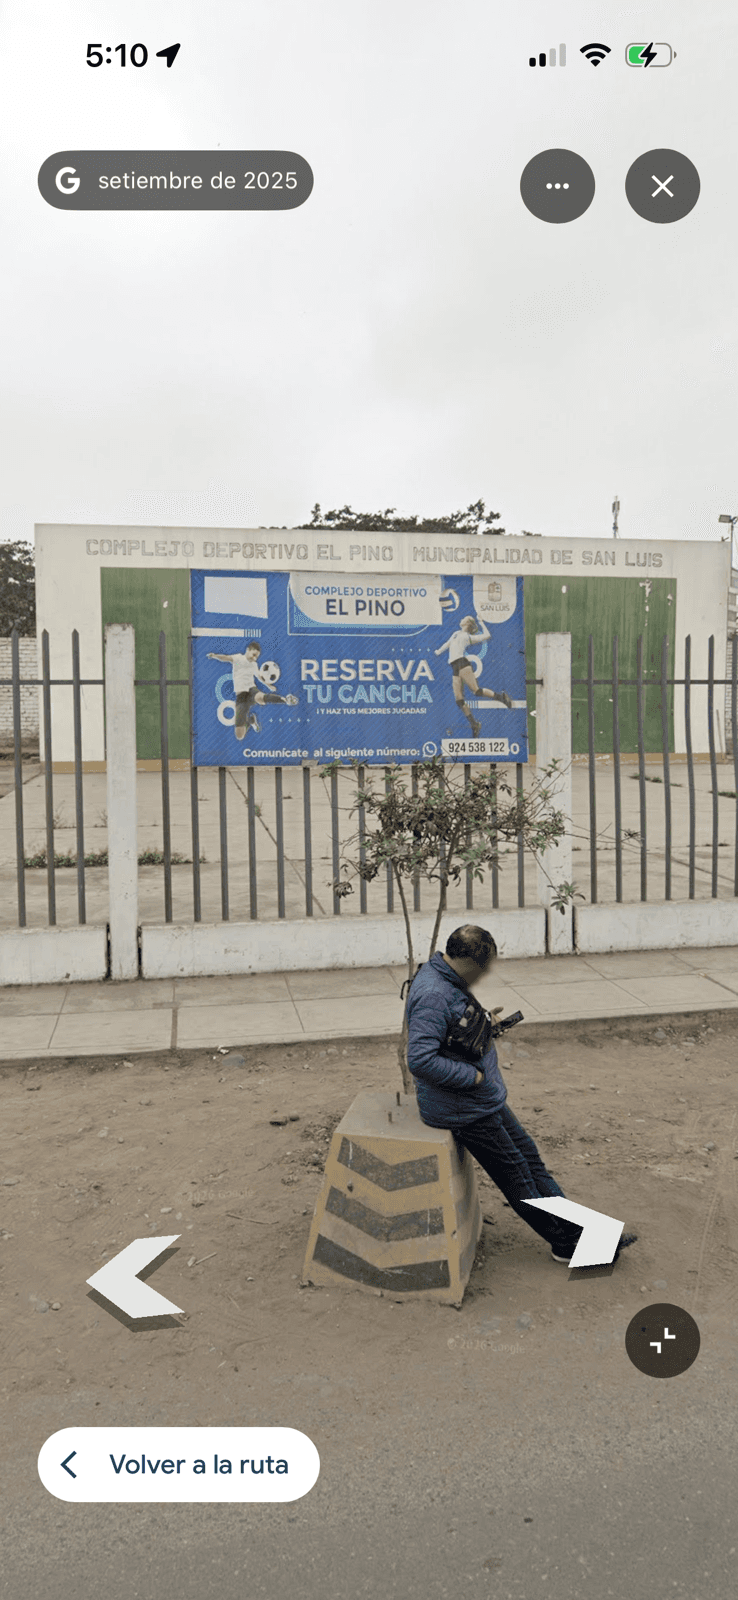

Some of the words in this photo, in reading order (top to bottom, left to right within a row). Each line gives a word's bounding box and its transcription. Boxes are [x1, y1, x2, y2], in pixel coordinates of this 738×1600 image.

[85, 539, 195, 557] COMPLEJO
[202, 541, 309, 560] DEPORTIVO
[316, 543, 342, 561] EL
[349, 544, 394, 561] PINO
[412, 546, 544, 565] MUNICIPALIDAD
[550, 549, 574, 566] DE
[581, 550, 616, 566] SAN
[624, 551, 663, 568] LUIS
[304, 585, 364, 597] COMPLEJO
[366, 587, 427, 598] DEPORTIVO
[325, 598, 349, 616] EL
[355, 599, 406, 617] PINO
[300, 658, 435, 682] RESERVA
[302, 684, 332, 704] TU
[337, 684, 433, 704] CANCHA
[326, 707, 342, 715] HAZ
[342, 707, 356, 715] TUS
[357, 707, 391, 715] MEJORES
[313, 747, 323, 758] al
[324, 745, 375, 760] siguiente
[376, 744, 420, 757] número:
[448, 742, 466, 753] 924
[468, 741, 486, 753] 538
[489, 741, 505, 753] 122
